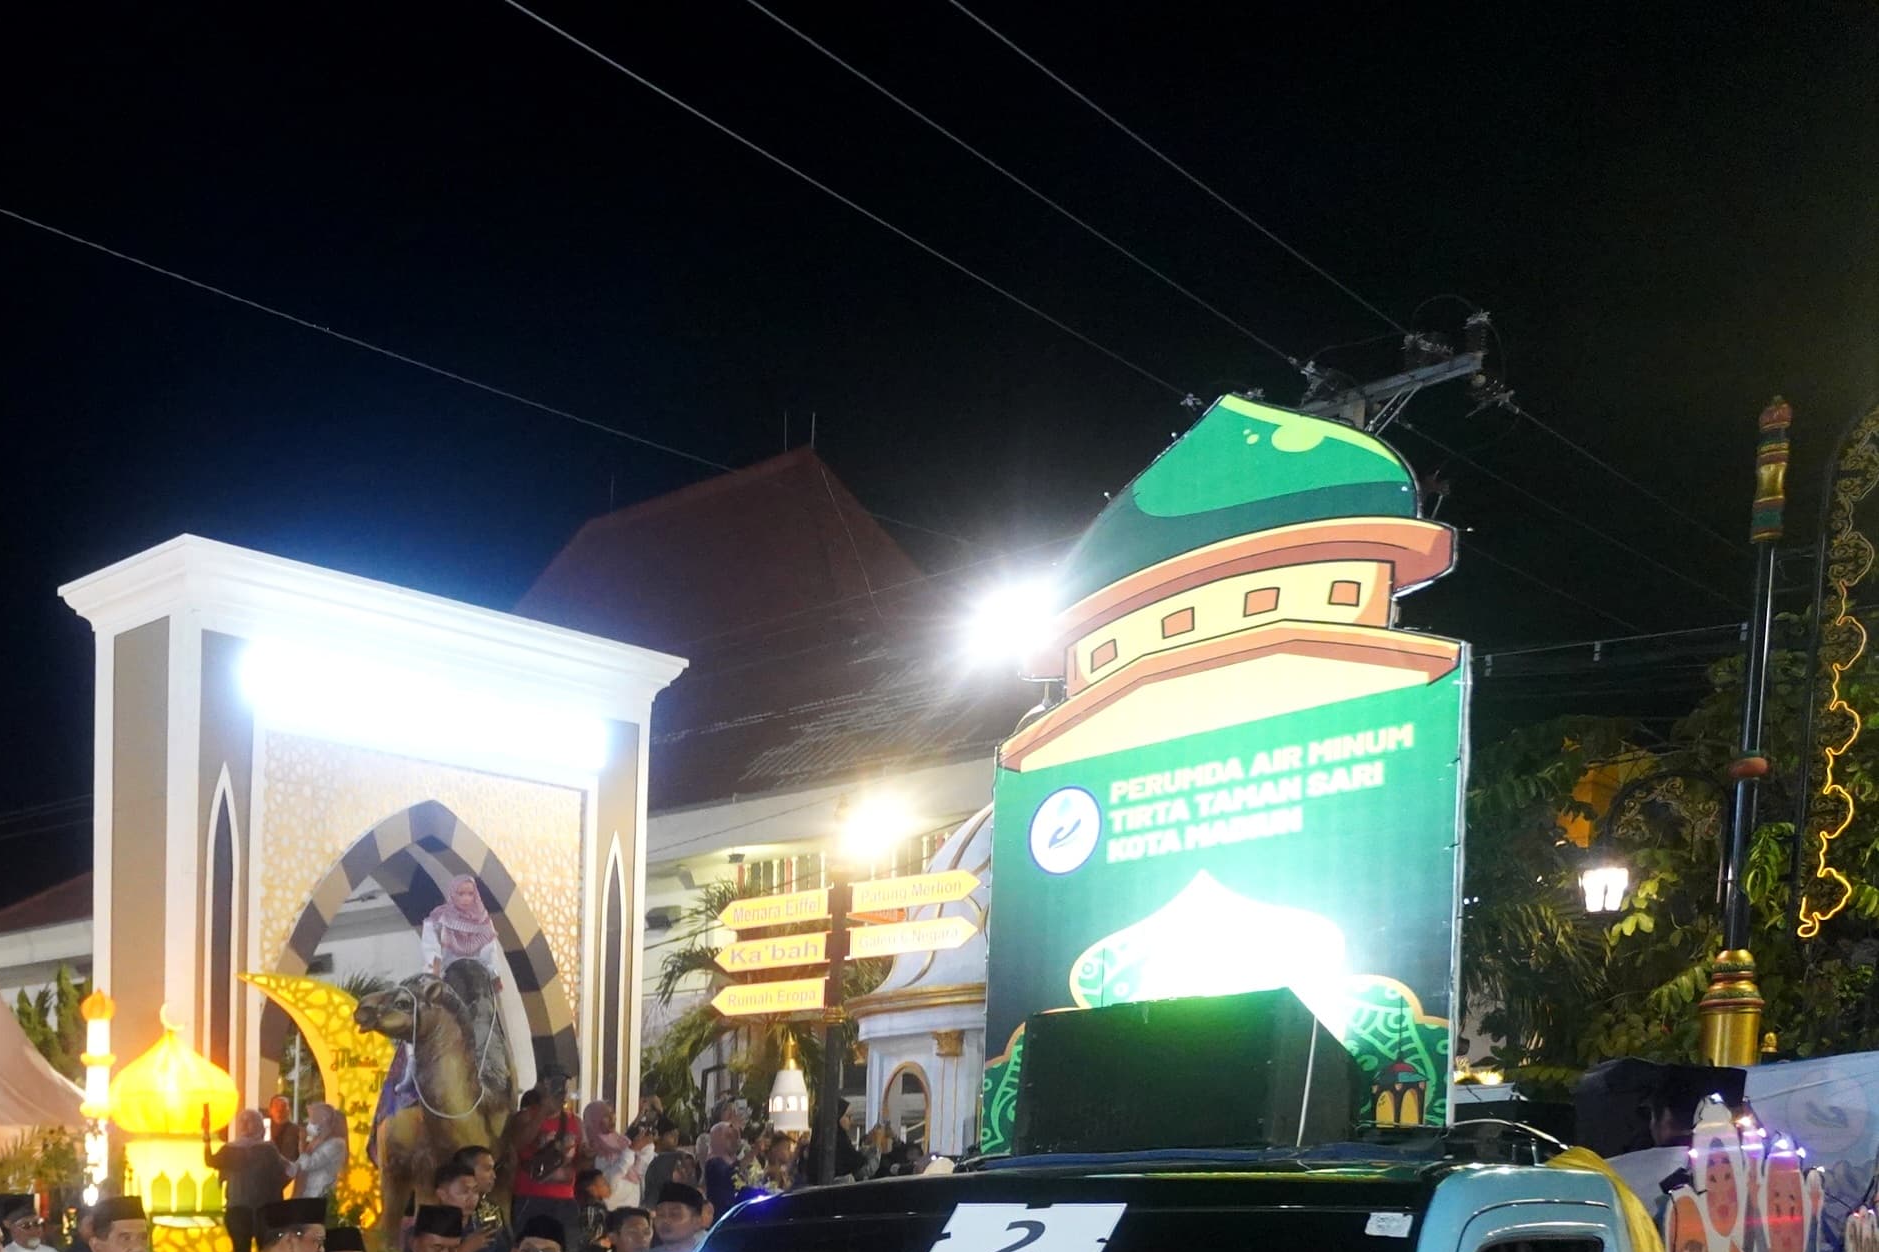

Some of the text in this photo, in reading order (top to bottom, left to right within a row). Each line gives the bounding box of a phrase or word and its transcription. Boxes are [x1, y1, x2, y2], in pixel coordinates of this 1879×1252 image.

[1109, 723, 1414, 804] PERUMDA AIR MINUM
[1108, 761, 1384, 833] TIRTA TAMAN SARI
[1106, 829, 1182, 863] KOTA
[861, 881, 961, 904] Patung Merlion
[733, 896, 821, 923] Menara Eiffel
[730, 941, 819, 965] Ka'bah
[728, 989, 816, 1007] Rumah Eropa
